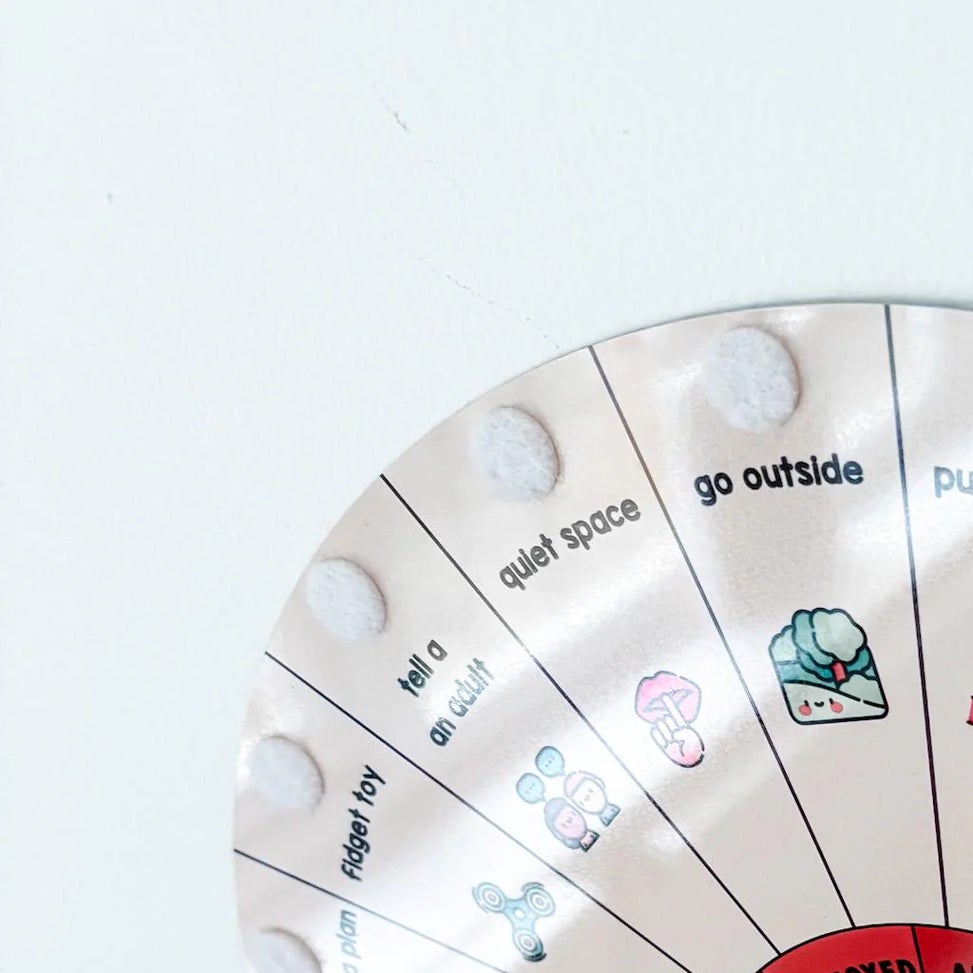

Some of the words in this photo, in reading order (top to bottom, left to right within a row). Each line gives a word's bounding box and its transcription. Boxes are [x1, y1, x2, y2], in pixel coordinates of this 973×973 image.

[694, 466, 732, 506] go
[744, 454, 865, 491] outside
[499, 534, 558, 591] quiet
[561, 498, 642, 551] space
[398, 653, 436, 697] tell
[427, 638, 448, 661] a
[429, 717, 456, 747] an
[449, 658, 495, 720] adult
[352, 765, 388, 808] toy
[342, 804, 374, 881] fidget
[336, 909, 361, 959] plan
